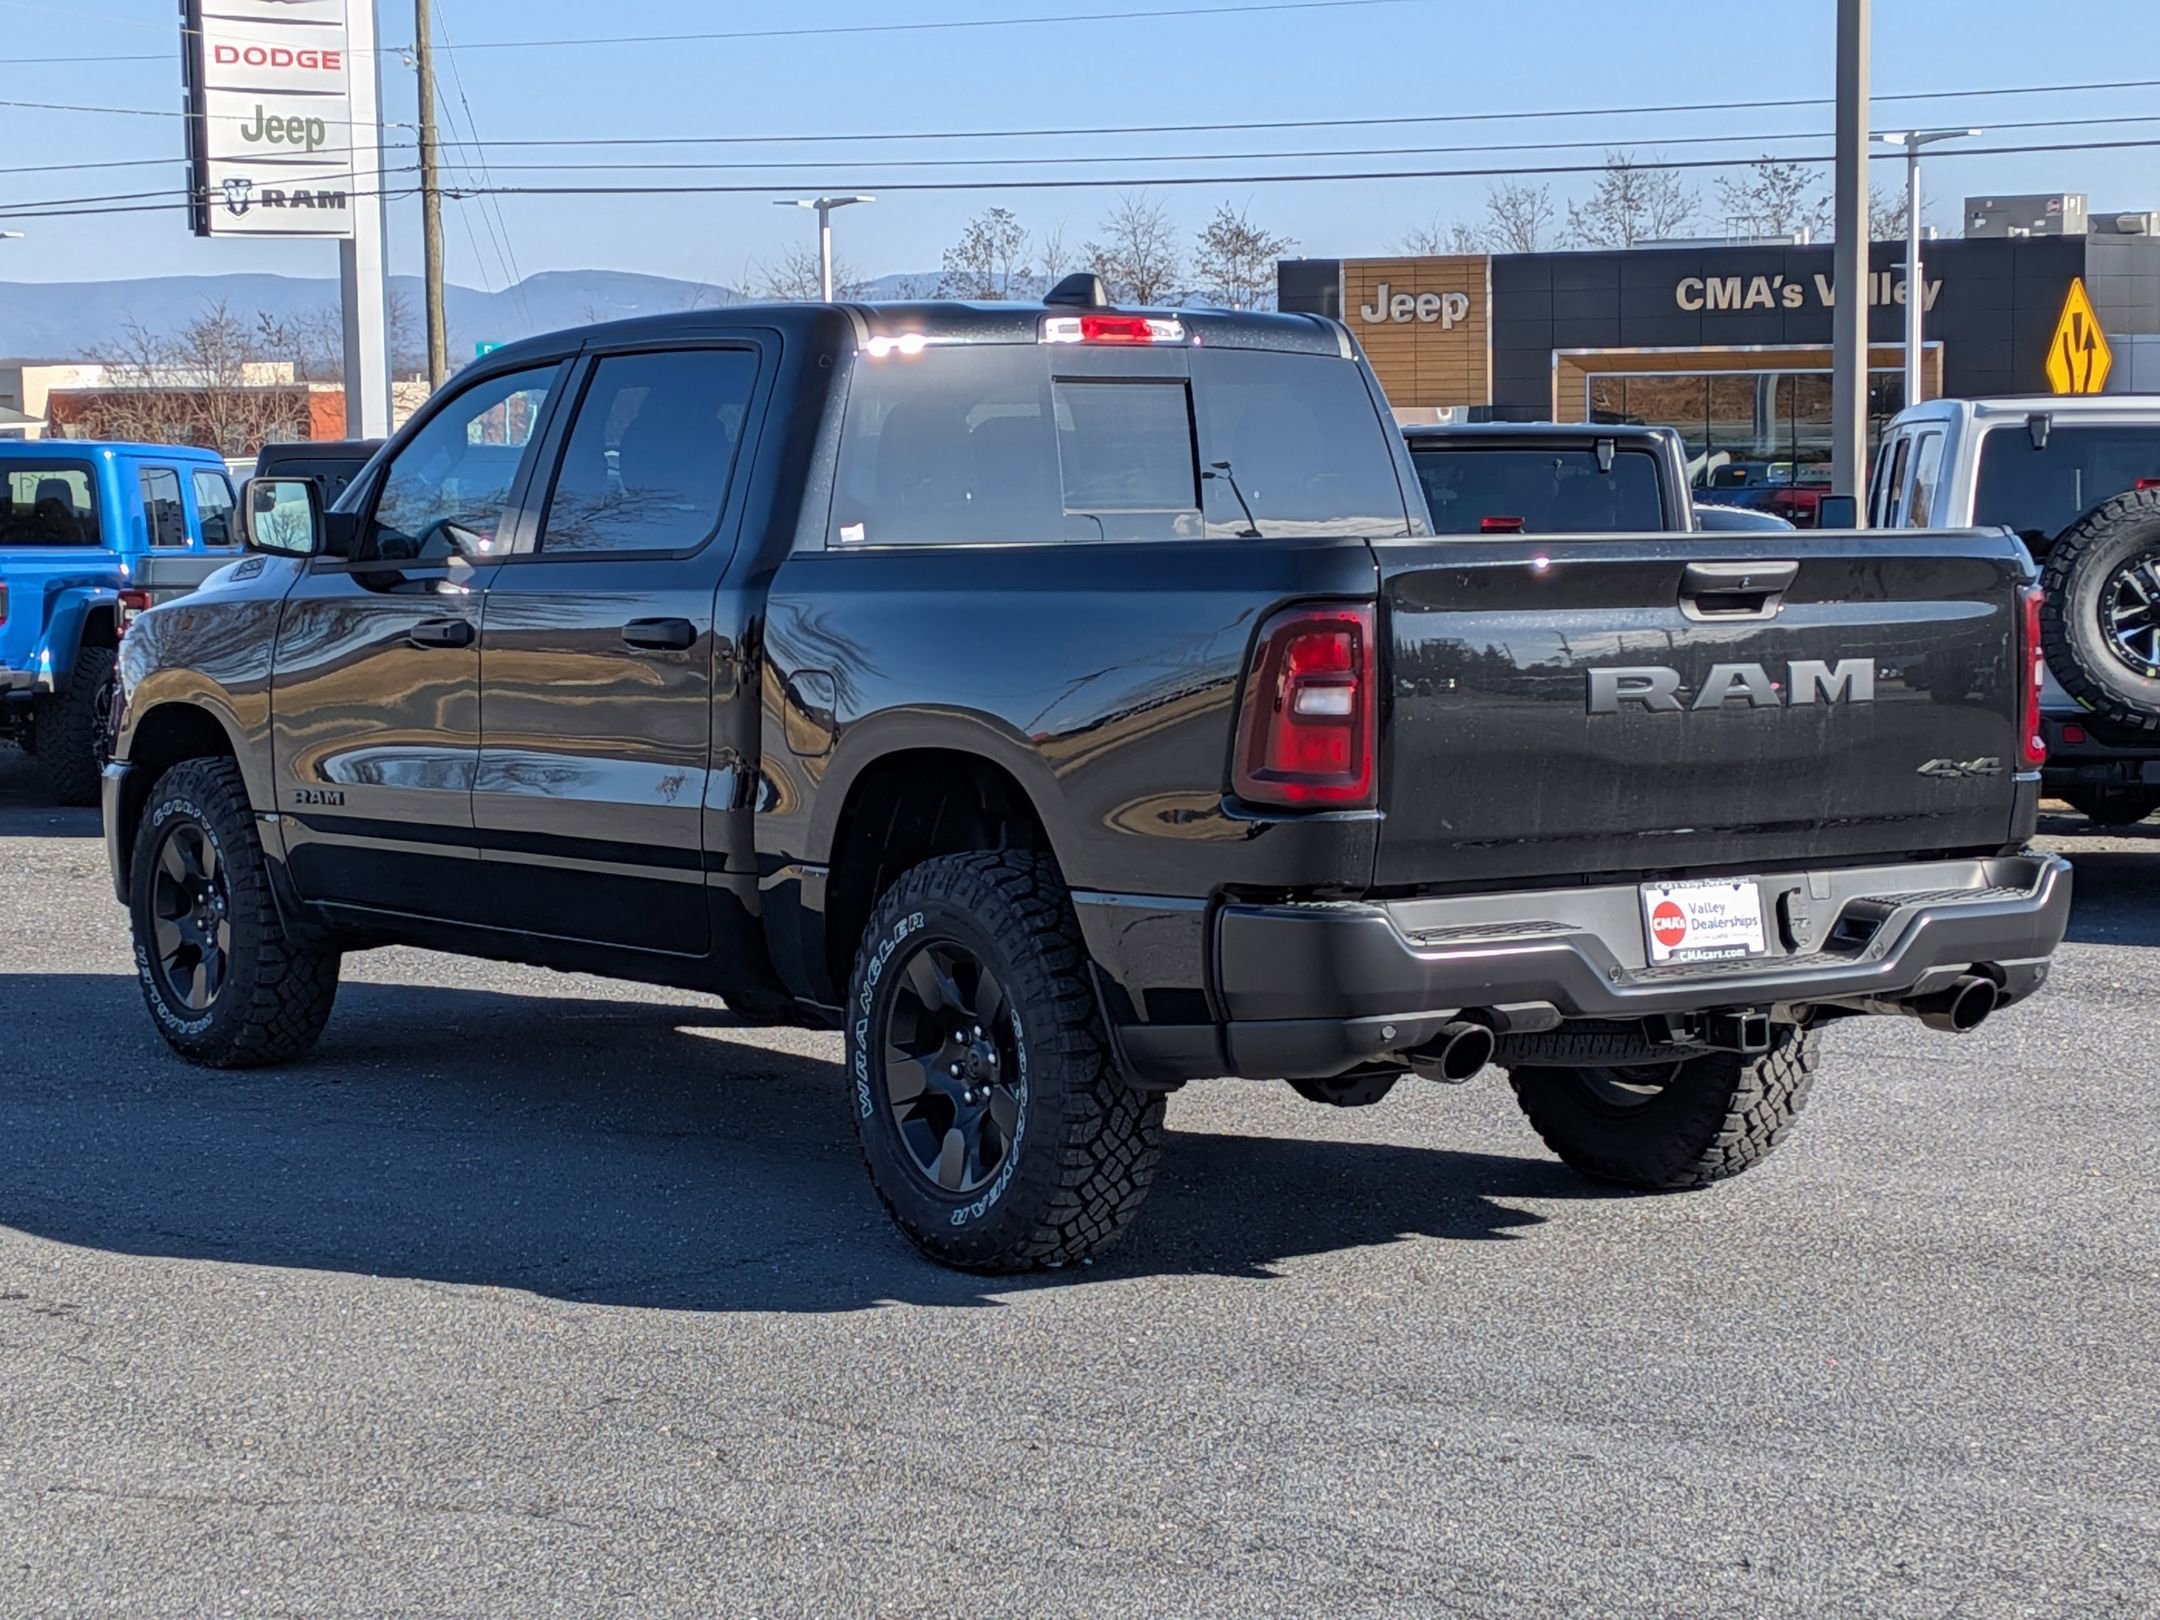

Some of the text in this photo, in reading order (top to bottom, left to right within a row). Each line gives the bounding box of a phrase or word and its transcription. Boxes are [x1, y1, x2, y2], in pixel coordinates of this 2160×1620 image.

[214, 45, 341, 70] DODGE
[241, 104, 325, 152] Jeep
[261, 189, 346, 209] RAM
[1361, 283, 1469, 330] Jeep
[1676, 271, 1943, 311] CMA's Vlley
[1586, 658, 1875, 716] RAM
[293, 789, 345, 806] RAM
[1688, 902, 1725, 916] Valley
[1691, 915, 1758, 930] Dealerships
[1680, 948, 1746, 961] CMAcars.com
[852, 911, 925, 1119] WRANGLER
[951, 1008, 1028, 1226] GOODYEAR
